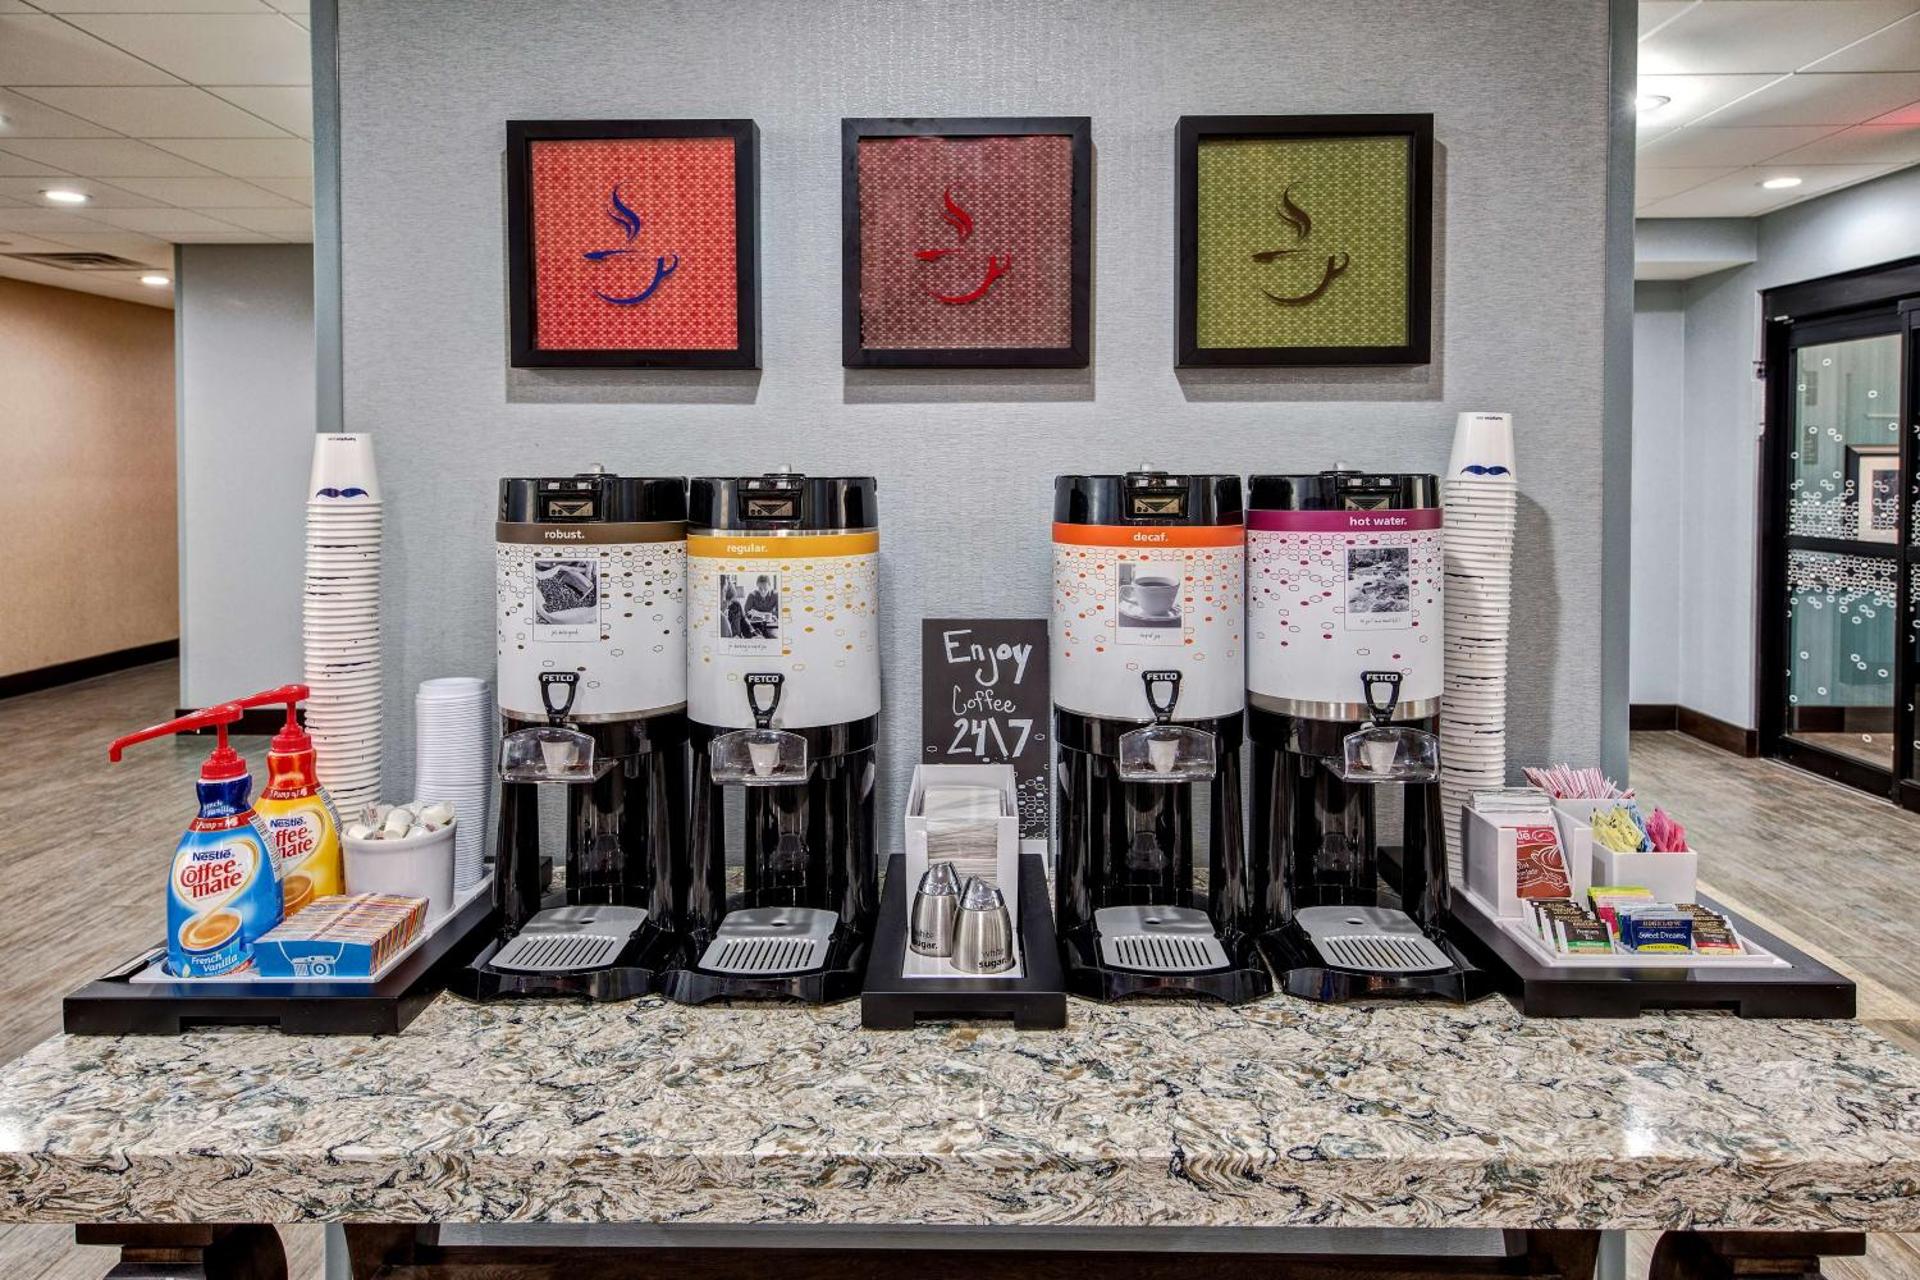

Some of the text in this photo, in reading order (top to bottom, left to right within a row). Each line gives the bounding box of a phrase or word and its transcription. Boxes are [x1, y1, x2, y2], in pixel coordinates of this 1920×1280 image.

[1349, 516, 1407, 526] hot water.
[544, 529, 585, 539] robust.
[1133, 532, 1169, 542] decaf.
[726, 544, 768, 554] regular.
[943, 629, 1033, 687] Enjoy
[543, 674, 574, 682] FETCO
[748, 674, 779, 683] FETCO
[1146, 672, 1177, 681] FETCO
[1366, 673, 1398, 682] FETCO
[952, 685, 1016, 716] Coffee
[193, 872, 242, 898] mate
